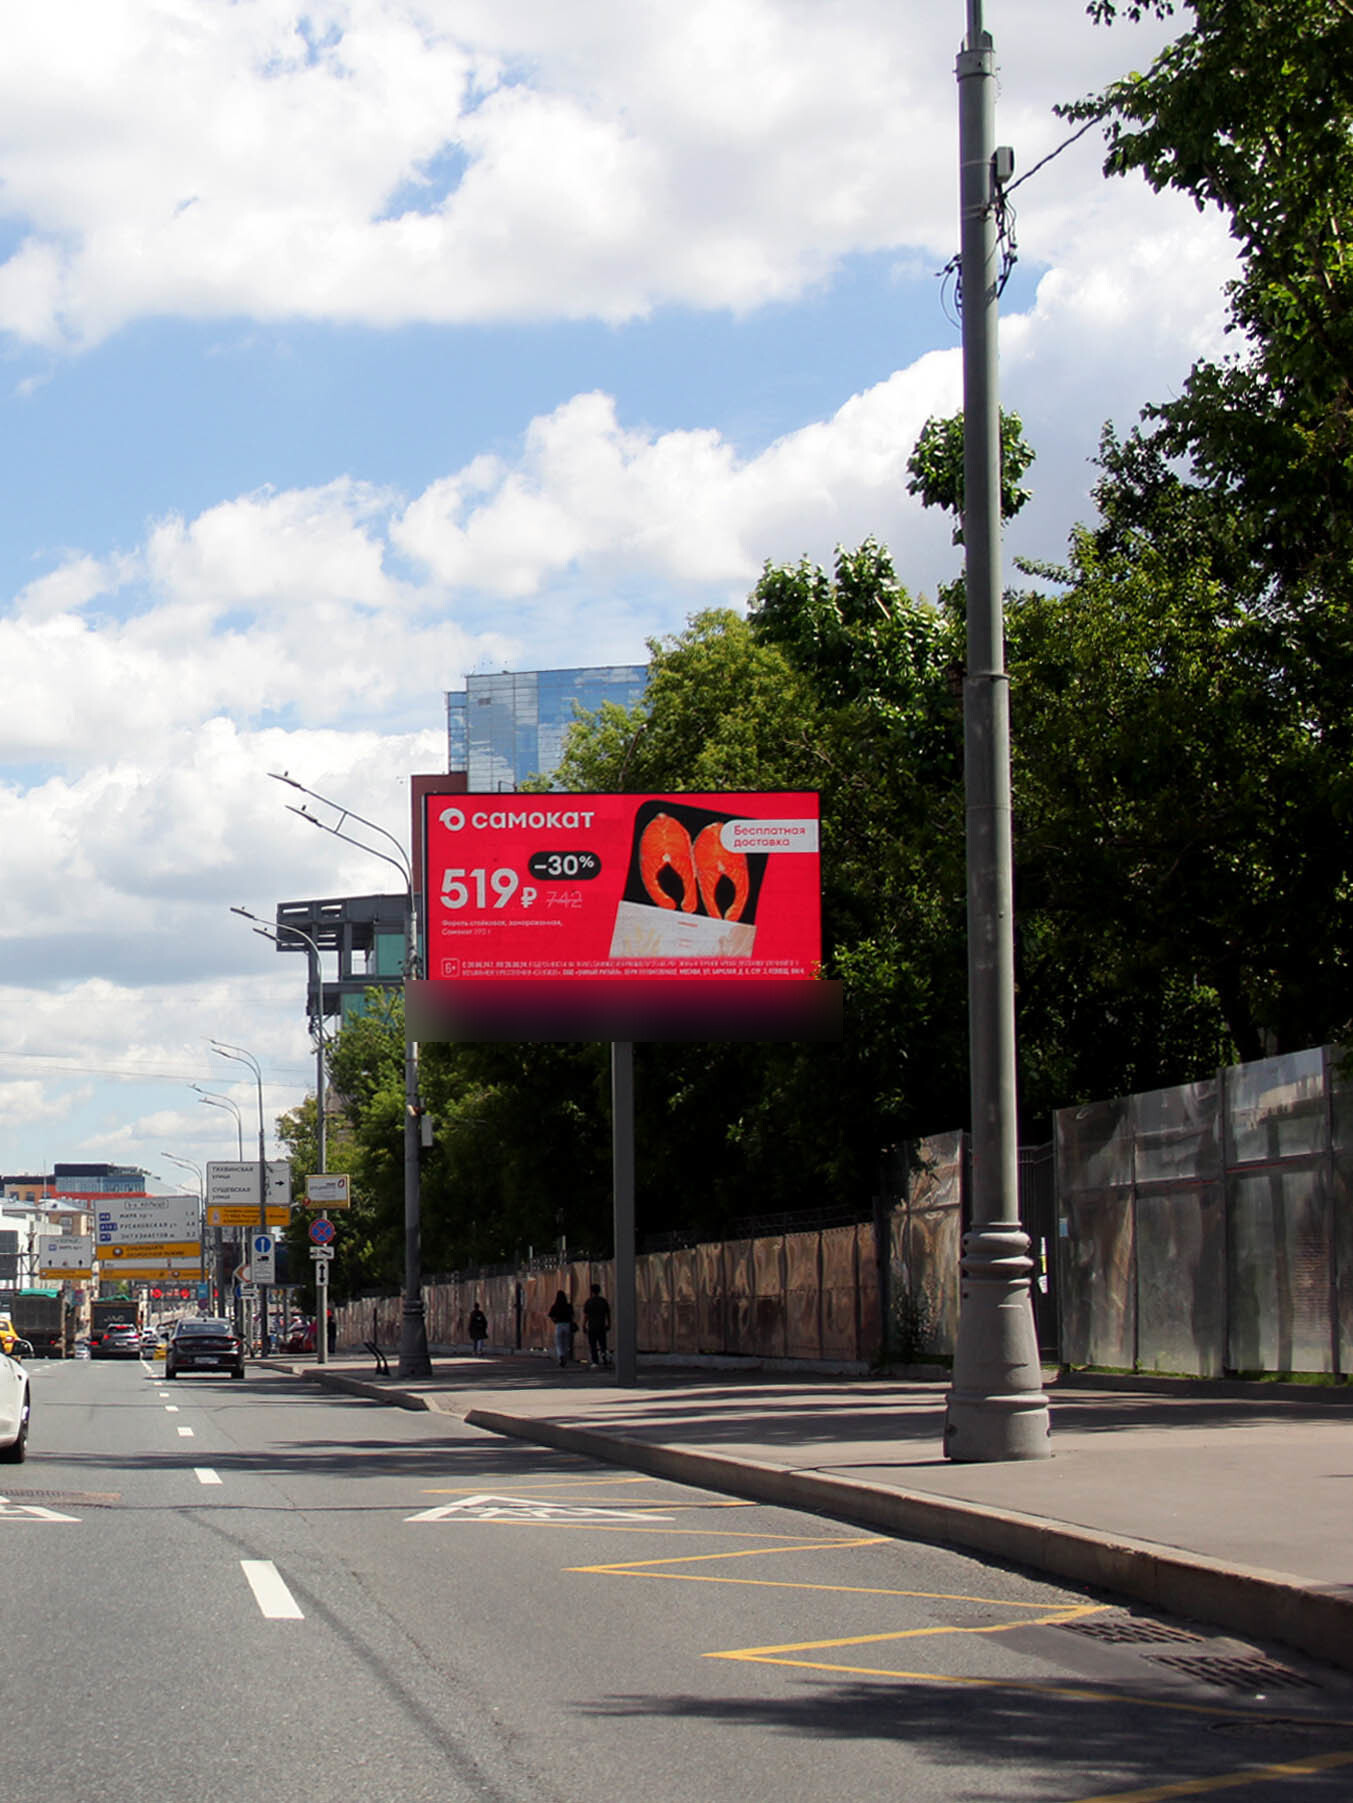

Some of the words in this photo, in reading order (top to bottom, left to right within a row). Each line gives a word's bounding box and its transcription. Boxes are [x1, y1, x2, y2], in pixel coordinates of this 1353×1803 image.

[471, 811, 595, 829] самокат
[734, 825, 806, 836] Бесплатная
[733, 839, 790, 848] доставка
[534, 855, 595, 876] -30%
